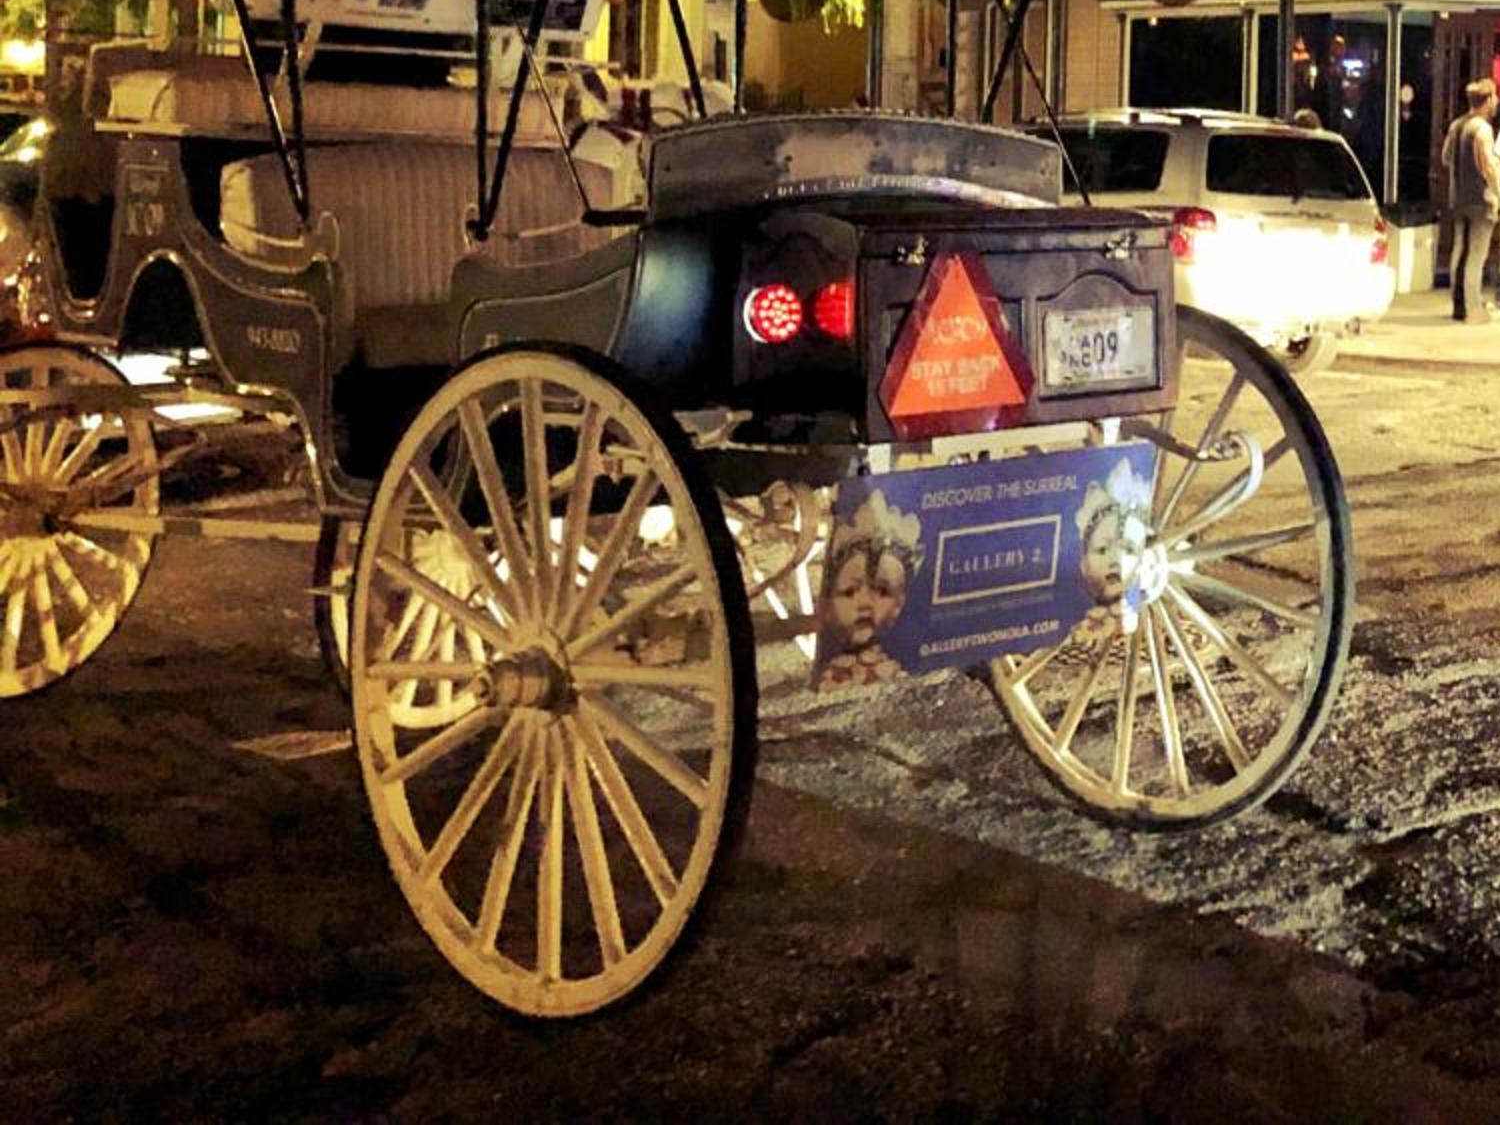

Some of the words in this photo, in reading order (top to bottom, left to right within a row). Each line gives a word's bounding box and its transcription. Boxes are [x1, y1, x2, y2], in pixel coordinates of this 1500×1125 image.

[921, 484, 993, 509] DISCOVER
[997, 479, 1021, 500] THE
[1023, 474, 1079, 496] SURREAL
